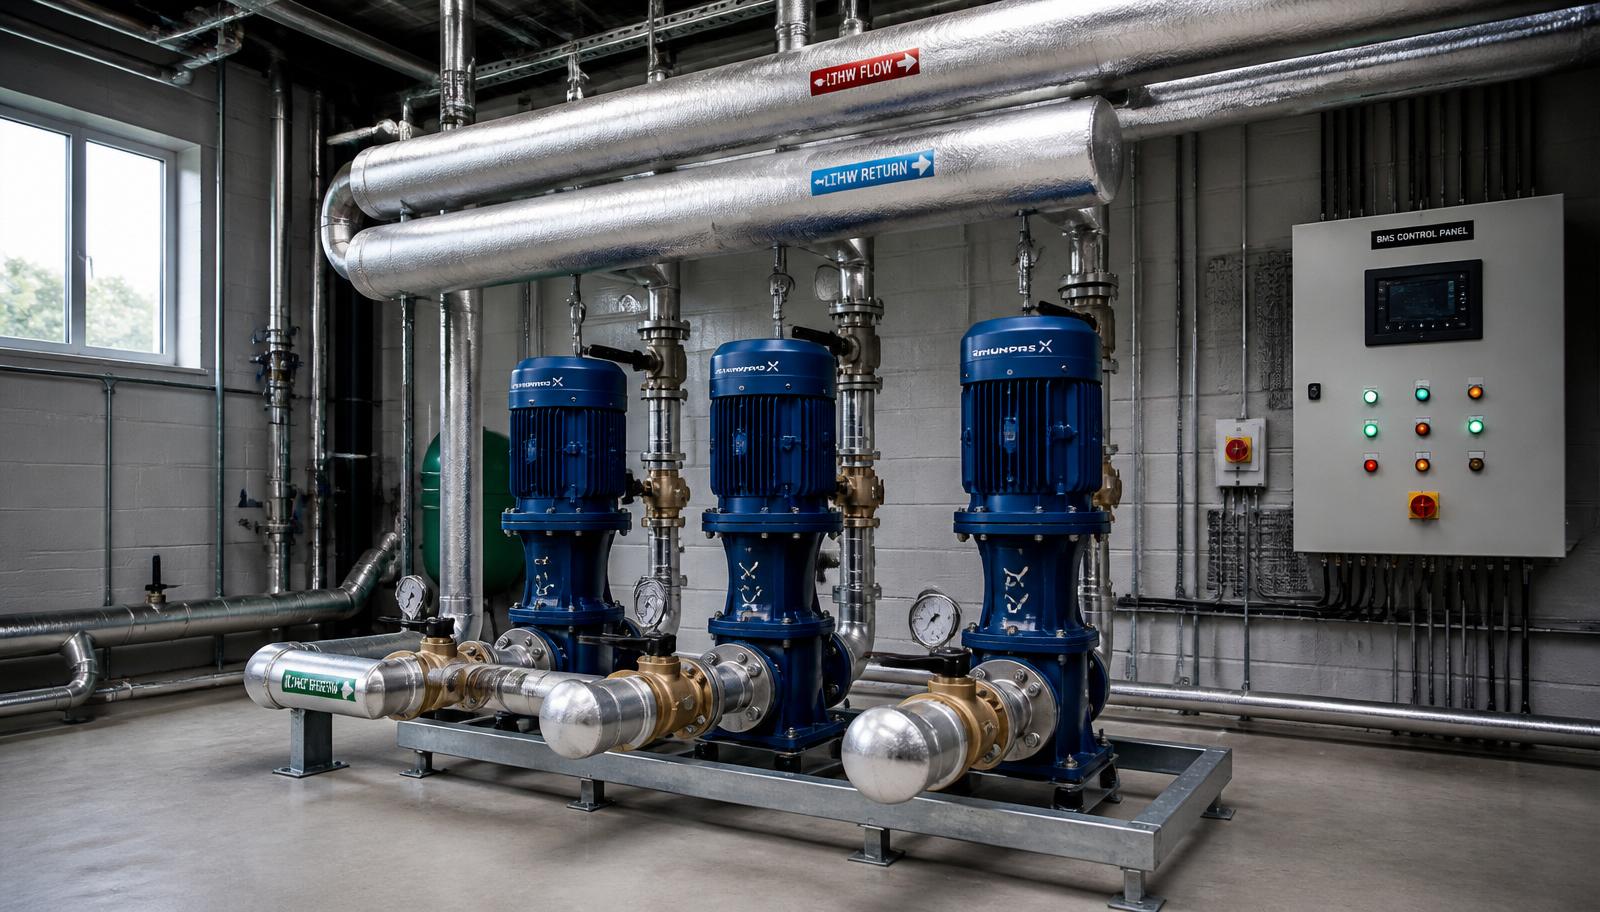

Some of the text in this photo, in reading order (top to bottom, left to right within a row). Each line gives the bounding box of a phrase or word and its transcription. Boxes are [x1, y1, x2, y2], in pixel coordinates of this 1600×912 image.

[860, 59, 893, 79] FLOW
[861, 160, 908, 181] RETURN
[1376, 226, 1469, 244] BMS CONTROL PANEL
